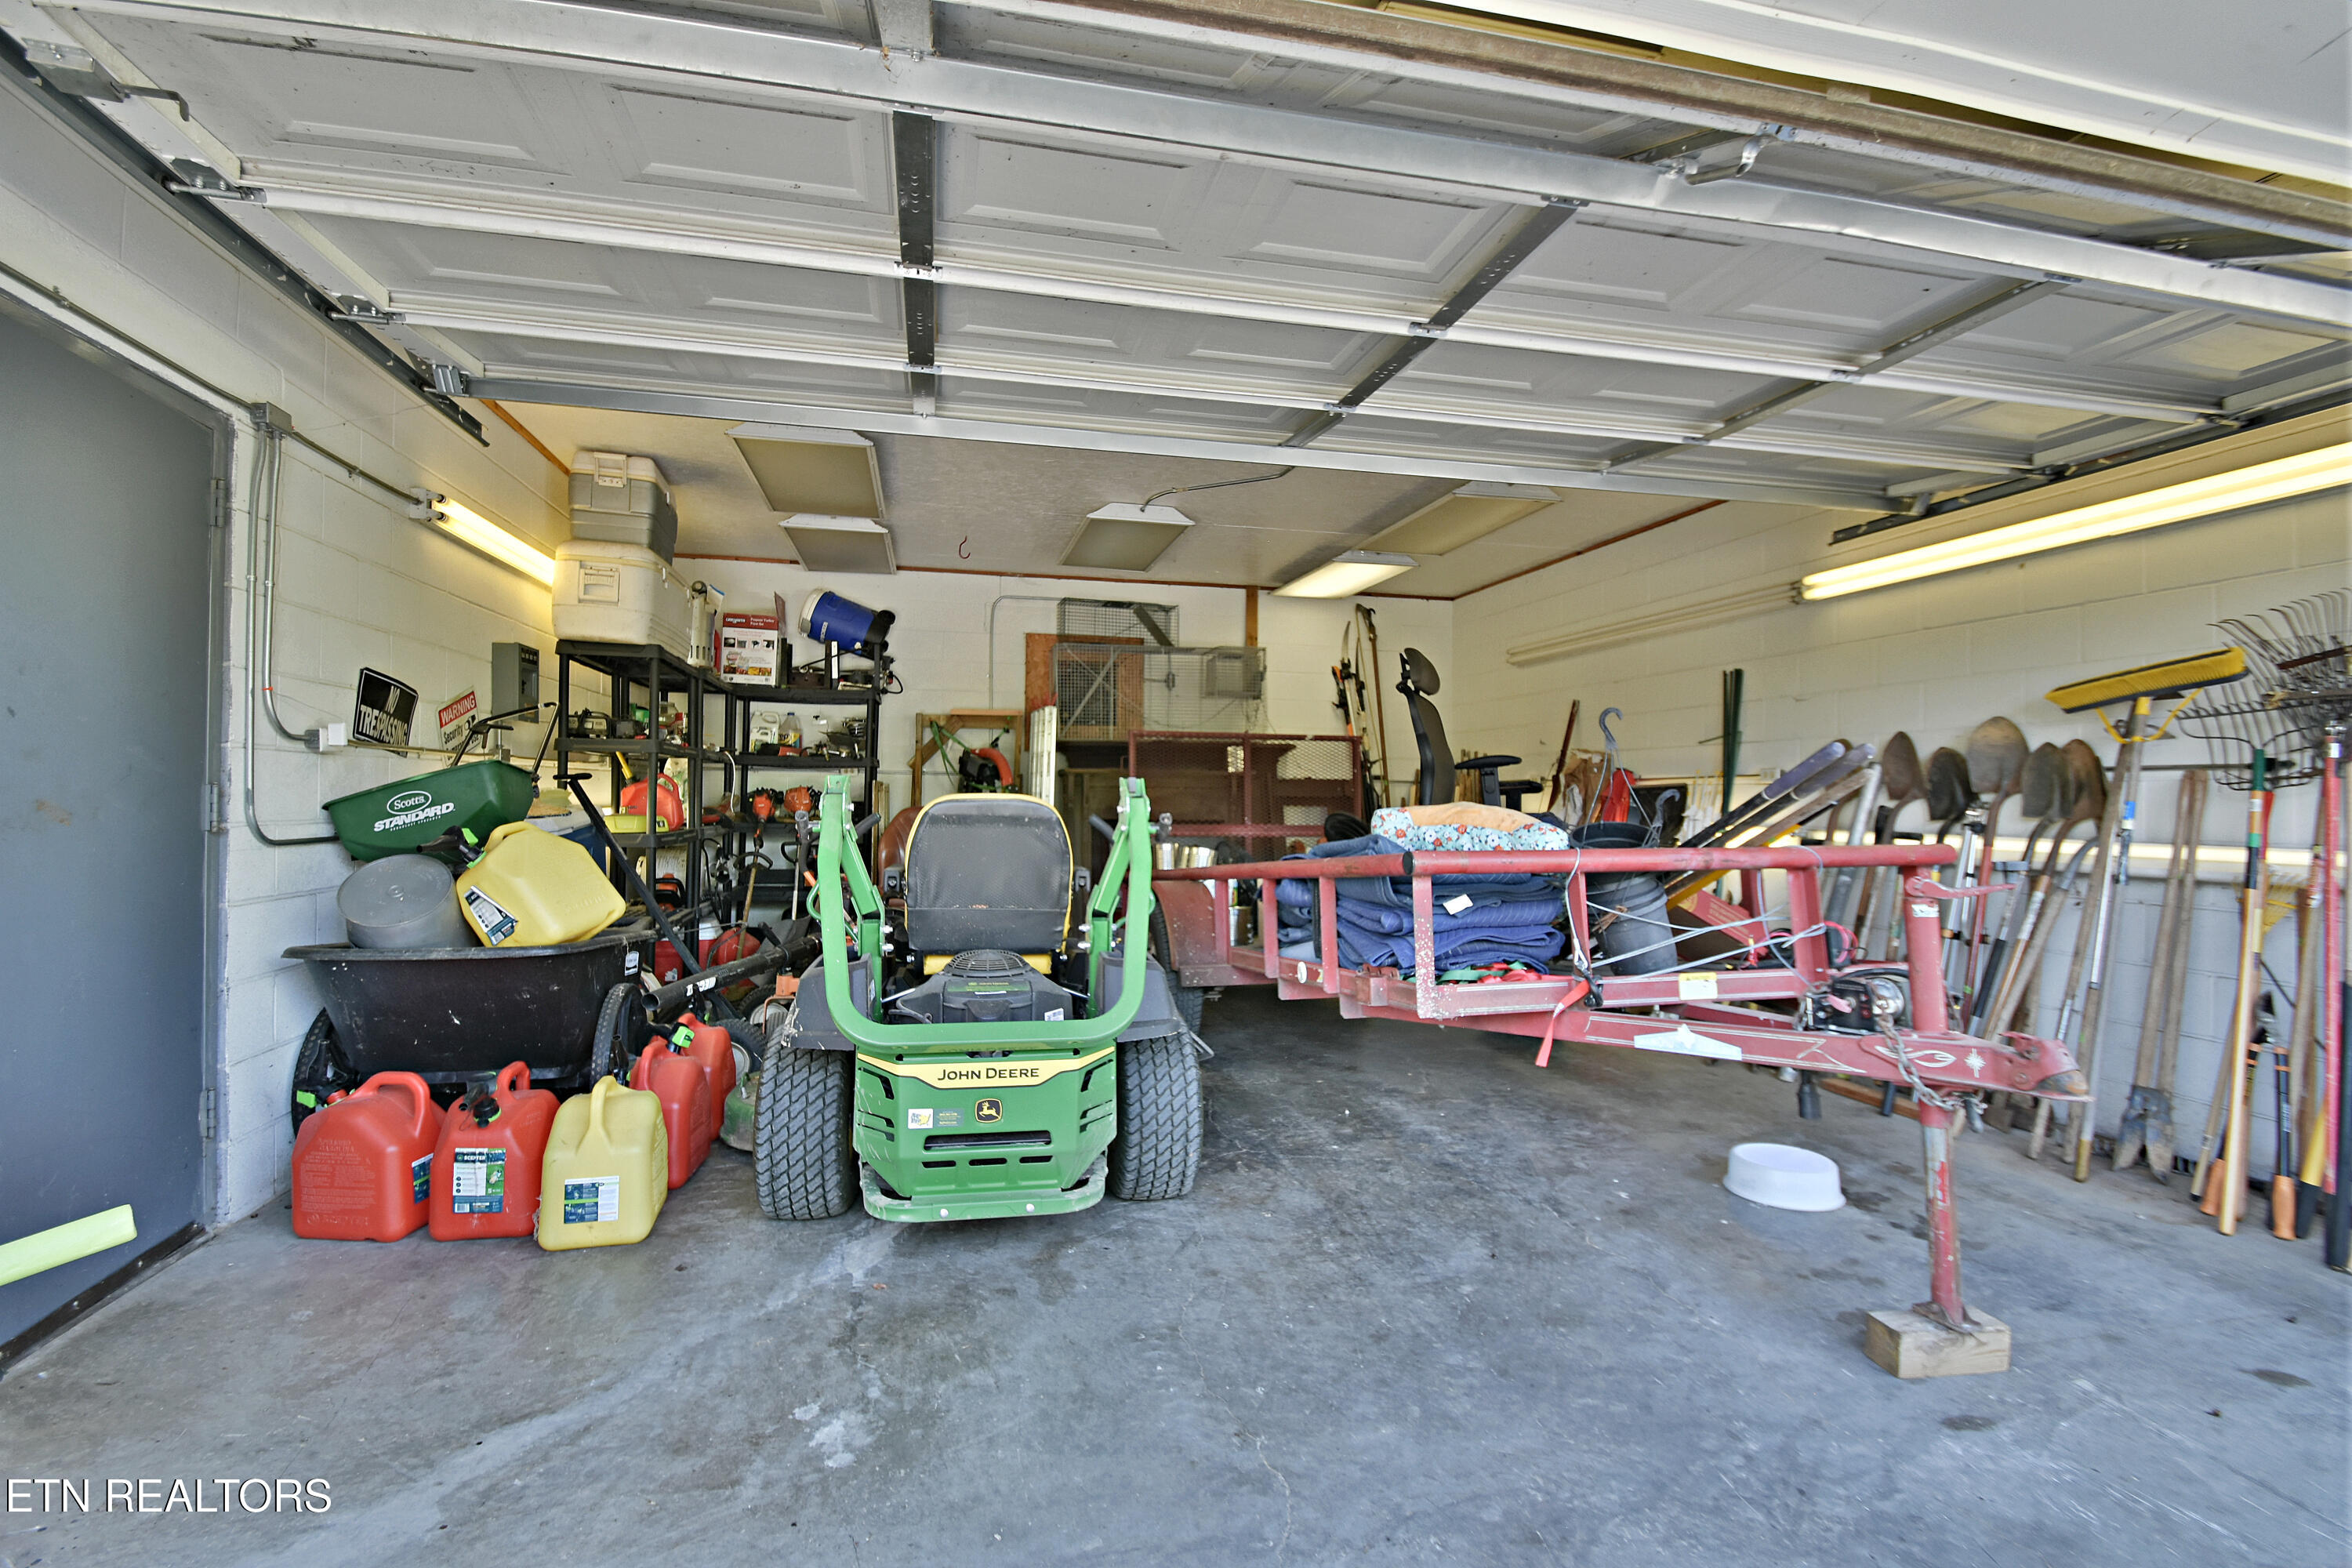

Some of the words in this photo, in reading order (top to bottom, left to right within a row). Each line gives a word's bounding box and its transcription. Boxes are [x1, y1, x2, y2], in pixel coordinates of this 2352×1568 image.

[386, 686, 400, 713] NO
[441, 695, 475, 725] WARNING
[359, 705, 408, 745] TRESPASSING
[444, 724, 463, 744] Security
[394, 796, 425, 810] Scotts
[374, 803, 455, 832] STANDARD
[938, 1069, 981, 1080] JOHN
[985, 1068, 1040, 1079] DEERE
